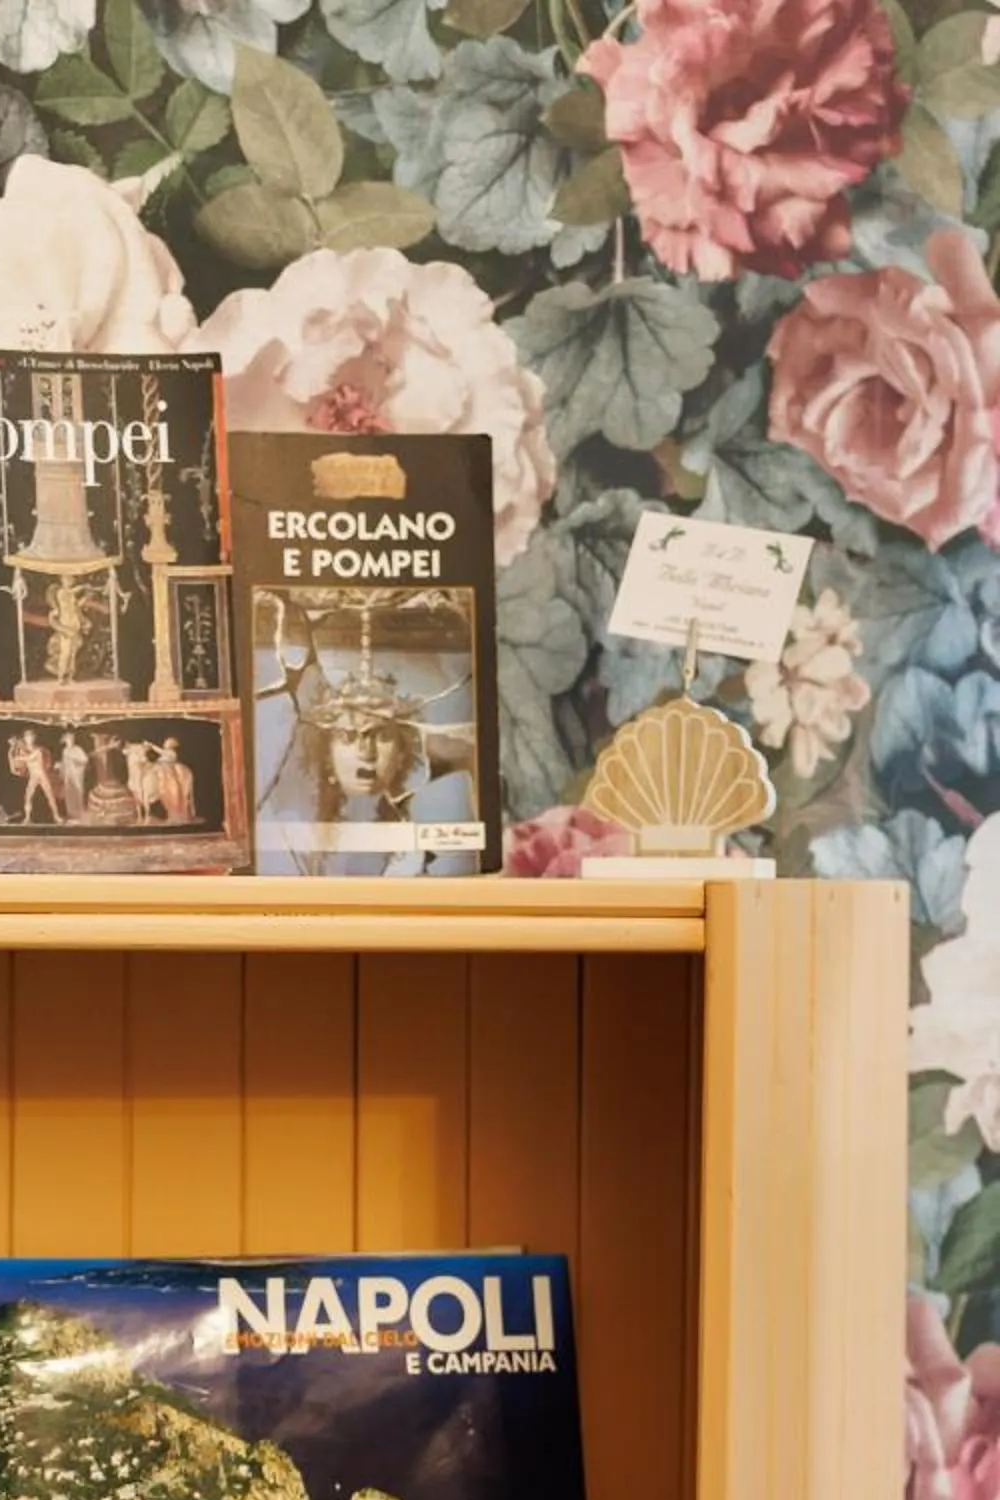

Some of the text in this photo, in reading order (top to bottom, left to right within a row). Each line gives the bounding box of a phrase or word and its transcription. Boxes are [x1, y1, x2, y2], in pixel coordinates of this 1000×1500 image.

[268, 510, 456, 541] ERCOLANO
[283, 547, 441, 578] E POMPEI
[216, 1275, 556, 1354] NAPOLI
[225, 1329, 421, 1348] EMOZIONI DAL CIELO
[406, 1350, 557, 1375] E CAMPANIA
